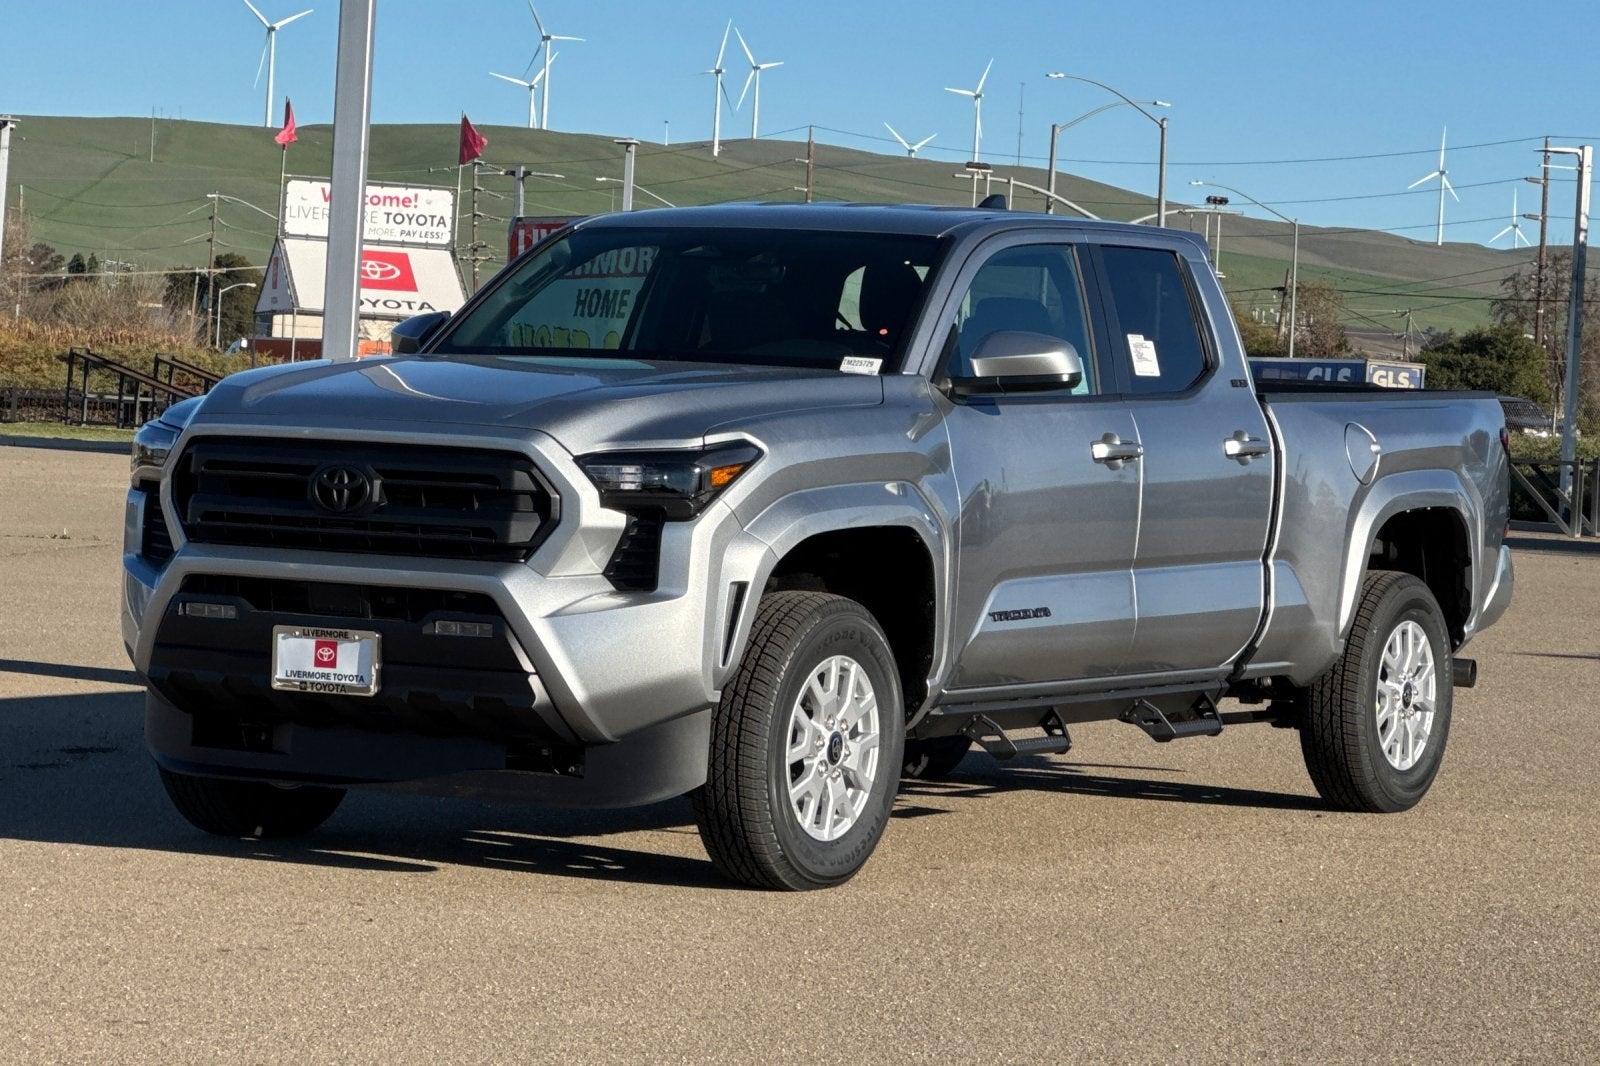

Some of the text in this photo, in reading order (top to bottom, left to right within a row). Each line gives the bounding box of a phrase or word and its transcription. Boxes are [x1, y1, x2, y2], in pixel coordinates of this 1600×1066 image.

[321, 187, 419, 209] Wcome!
[384, 212, 448, 228] TOYOTA
[400, 229, 417, 239] PAY
[418, 230, 444, 240] LESS!
[574, 288, 631, 319] HOME
[302, 629, 349, 640] LIVERMORE
[285, 670, 365, 684] LIVERMORE TOYOTA
[309, 682, 347, 693] TOYOTA
